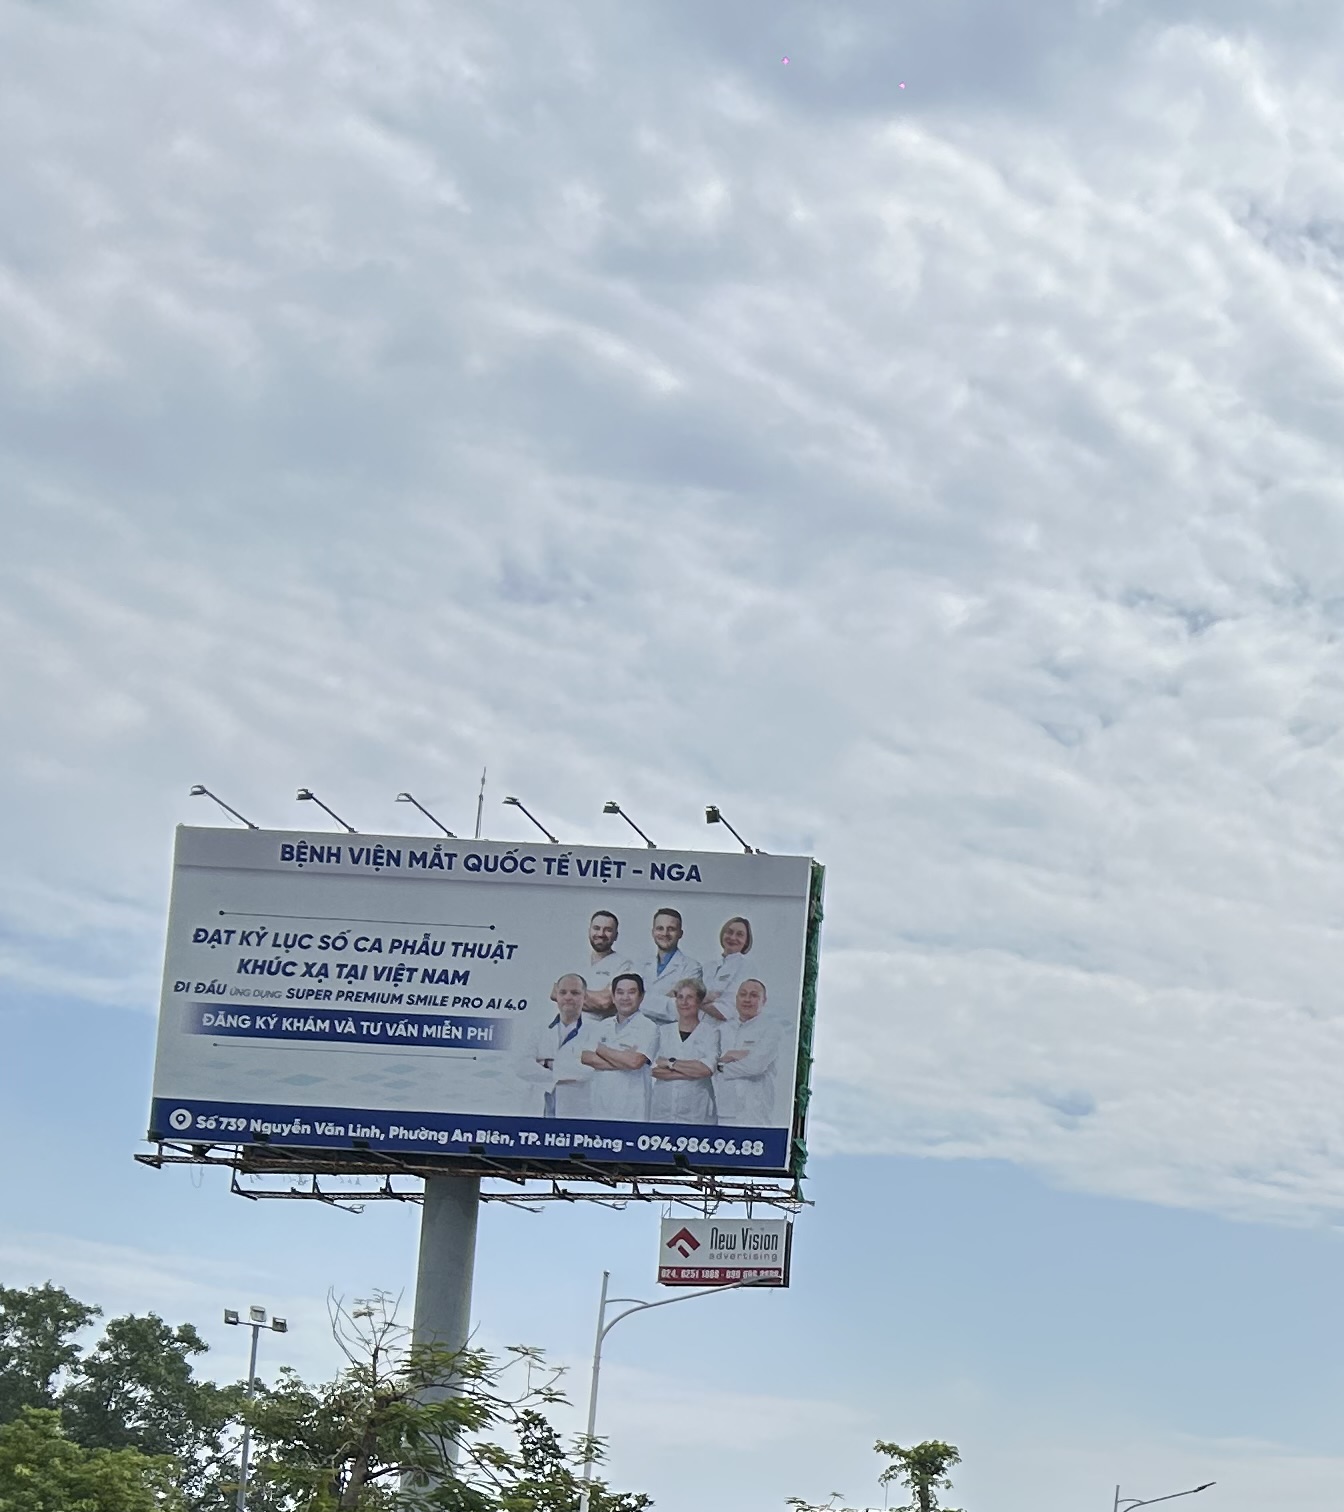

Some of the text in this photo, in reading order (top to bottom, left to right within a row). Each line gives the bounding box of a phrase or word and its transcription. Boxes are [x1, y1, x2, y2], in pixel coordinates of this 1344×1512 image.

[280, 840, 702, 883] BỆNH VIỆN MẮT QUỐC TẾ VIỆT NGA
[192, 926, 518, 964] ĐẠT KỶ LỤC SỐ CA PHẪU THUẬT
[237, 956, 470, 987] KHÚC XẠ TẠI VIỆT NAM
[202, 1010, 494, 1041] ĐĂNG KÝ KHÁM VÀ TƯ VẤN MIỄN PHÍ
[196, 1114, 764, 1156] Số 739 Nguyễn Văn Linh, Phường An Biên, TP. Hải Phòng 094.986.96.88
[710, 1227, 778, 1250] New Vision
[709, 1252, 778, 1262] advertising
